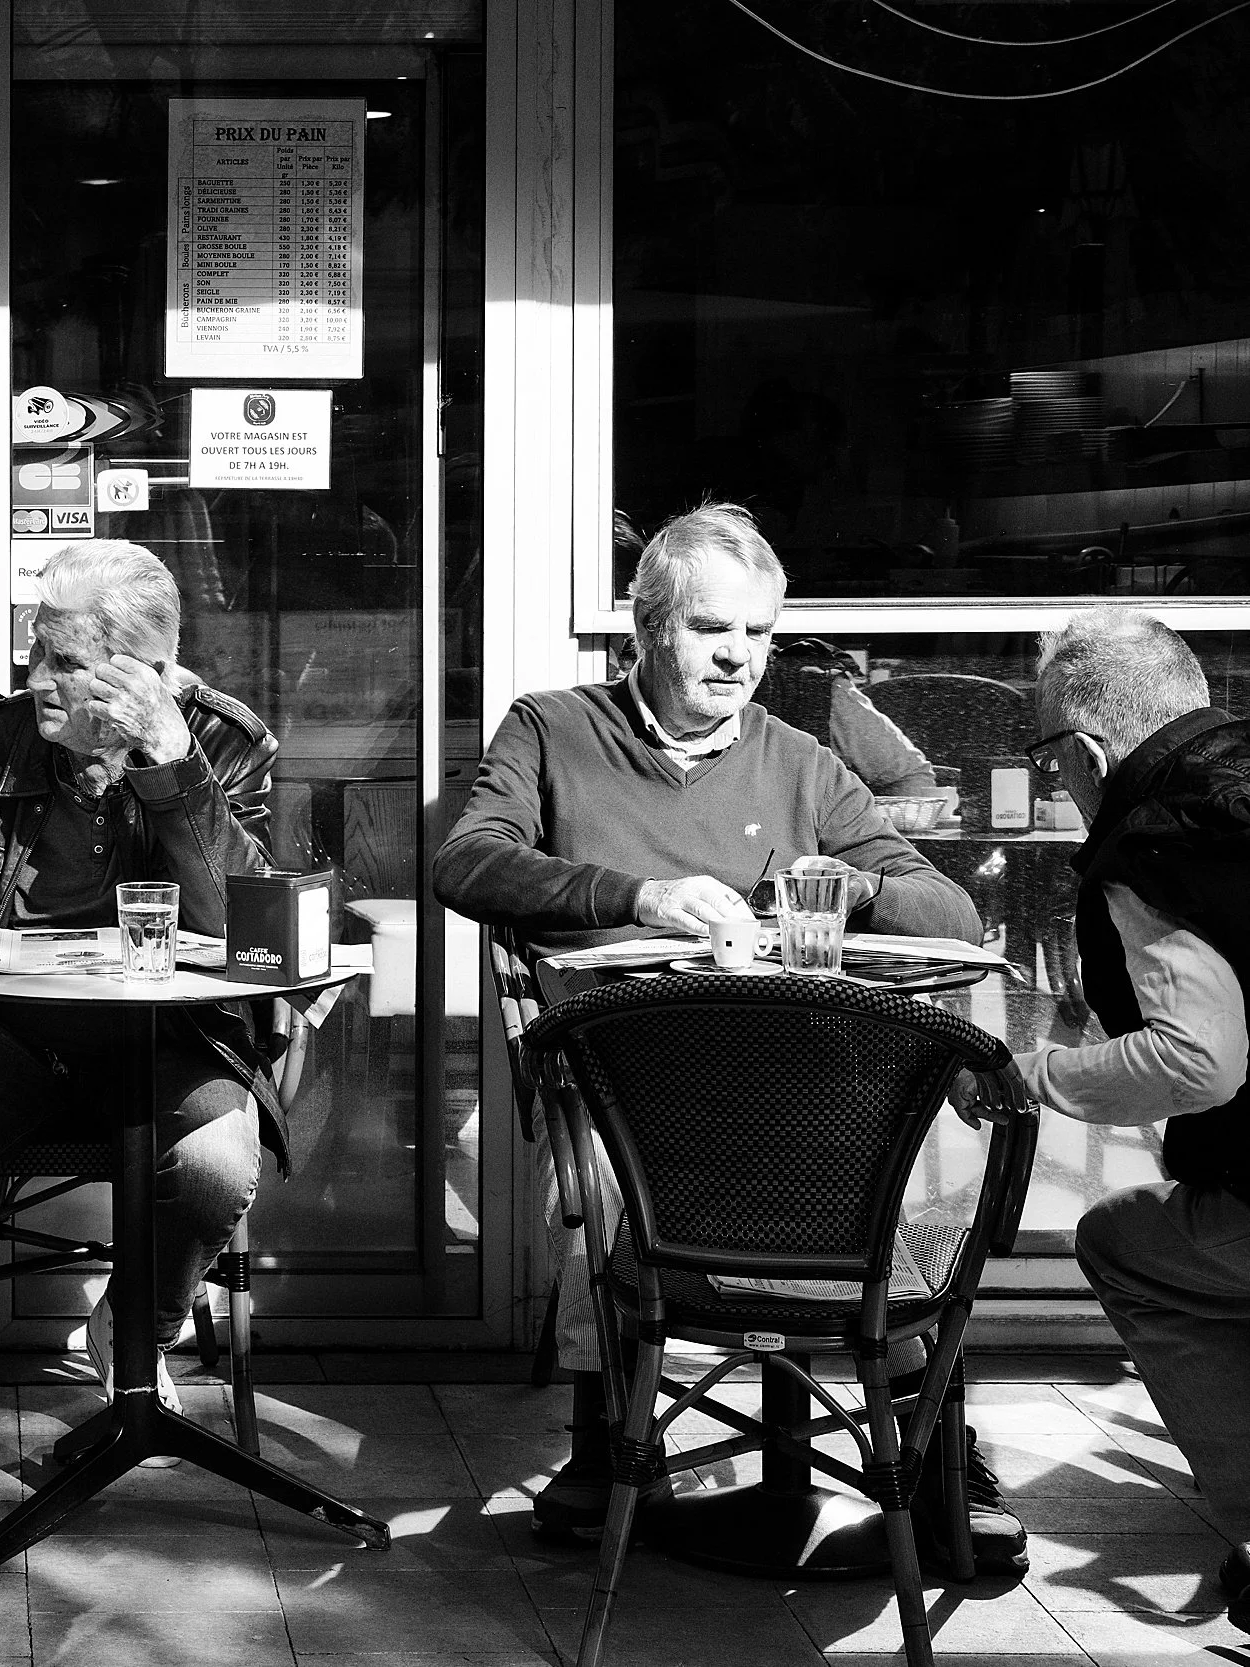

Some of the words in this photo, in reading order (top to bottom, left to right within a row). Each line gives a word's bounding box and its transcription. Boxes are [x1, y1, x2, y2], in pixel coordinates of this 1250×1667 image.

[215, 128, 256, 141] PRIX
[260, 128, 282, 141] DU
[286, 128, 326, 141] PAIN
[182, 186, 192, 209] longs
[287, 345, 299, 353] 5,5
[211, 432, 241, 440] VOTRE
[244, 432, 290, 440] MAGASIN
[292, 432, 308, 440] EST
[242, 447, 267, 455] TOUS
[270, 447, 285, 455] LES
[287, 447, 317, 455] JOURS
[57, 512, 89, 524] VISA
[18, 567, 40, 577] Res
[236, 951, 282, 964] COSTADORO
